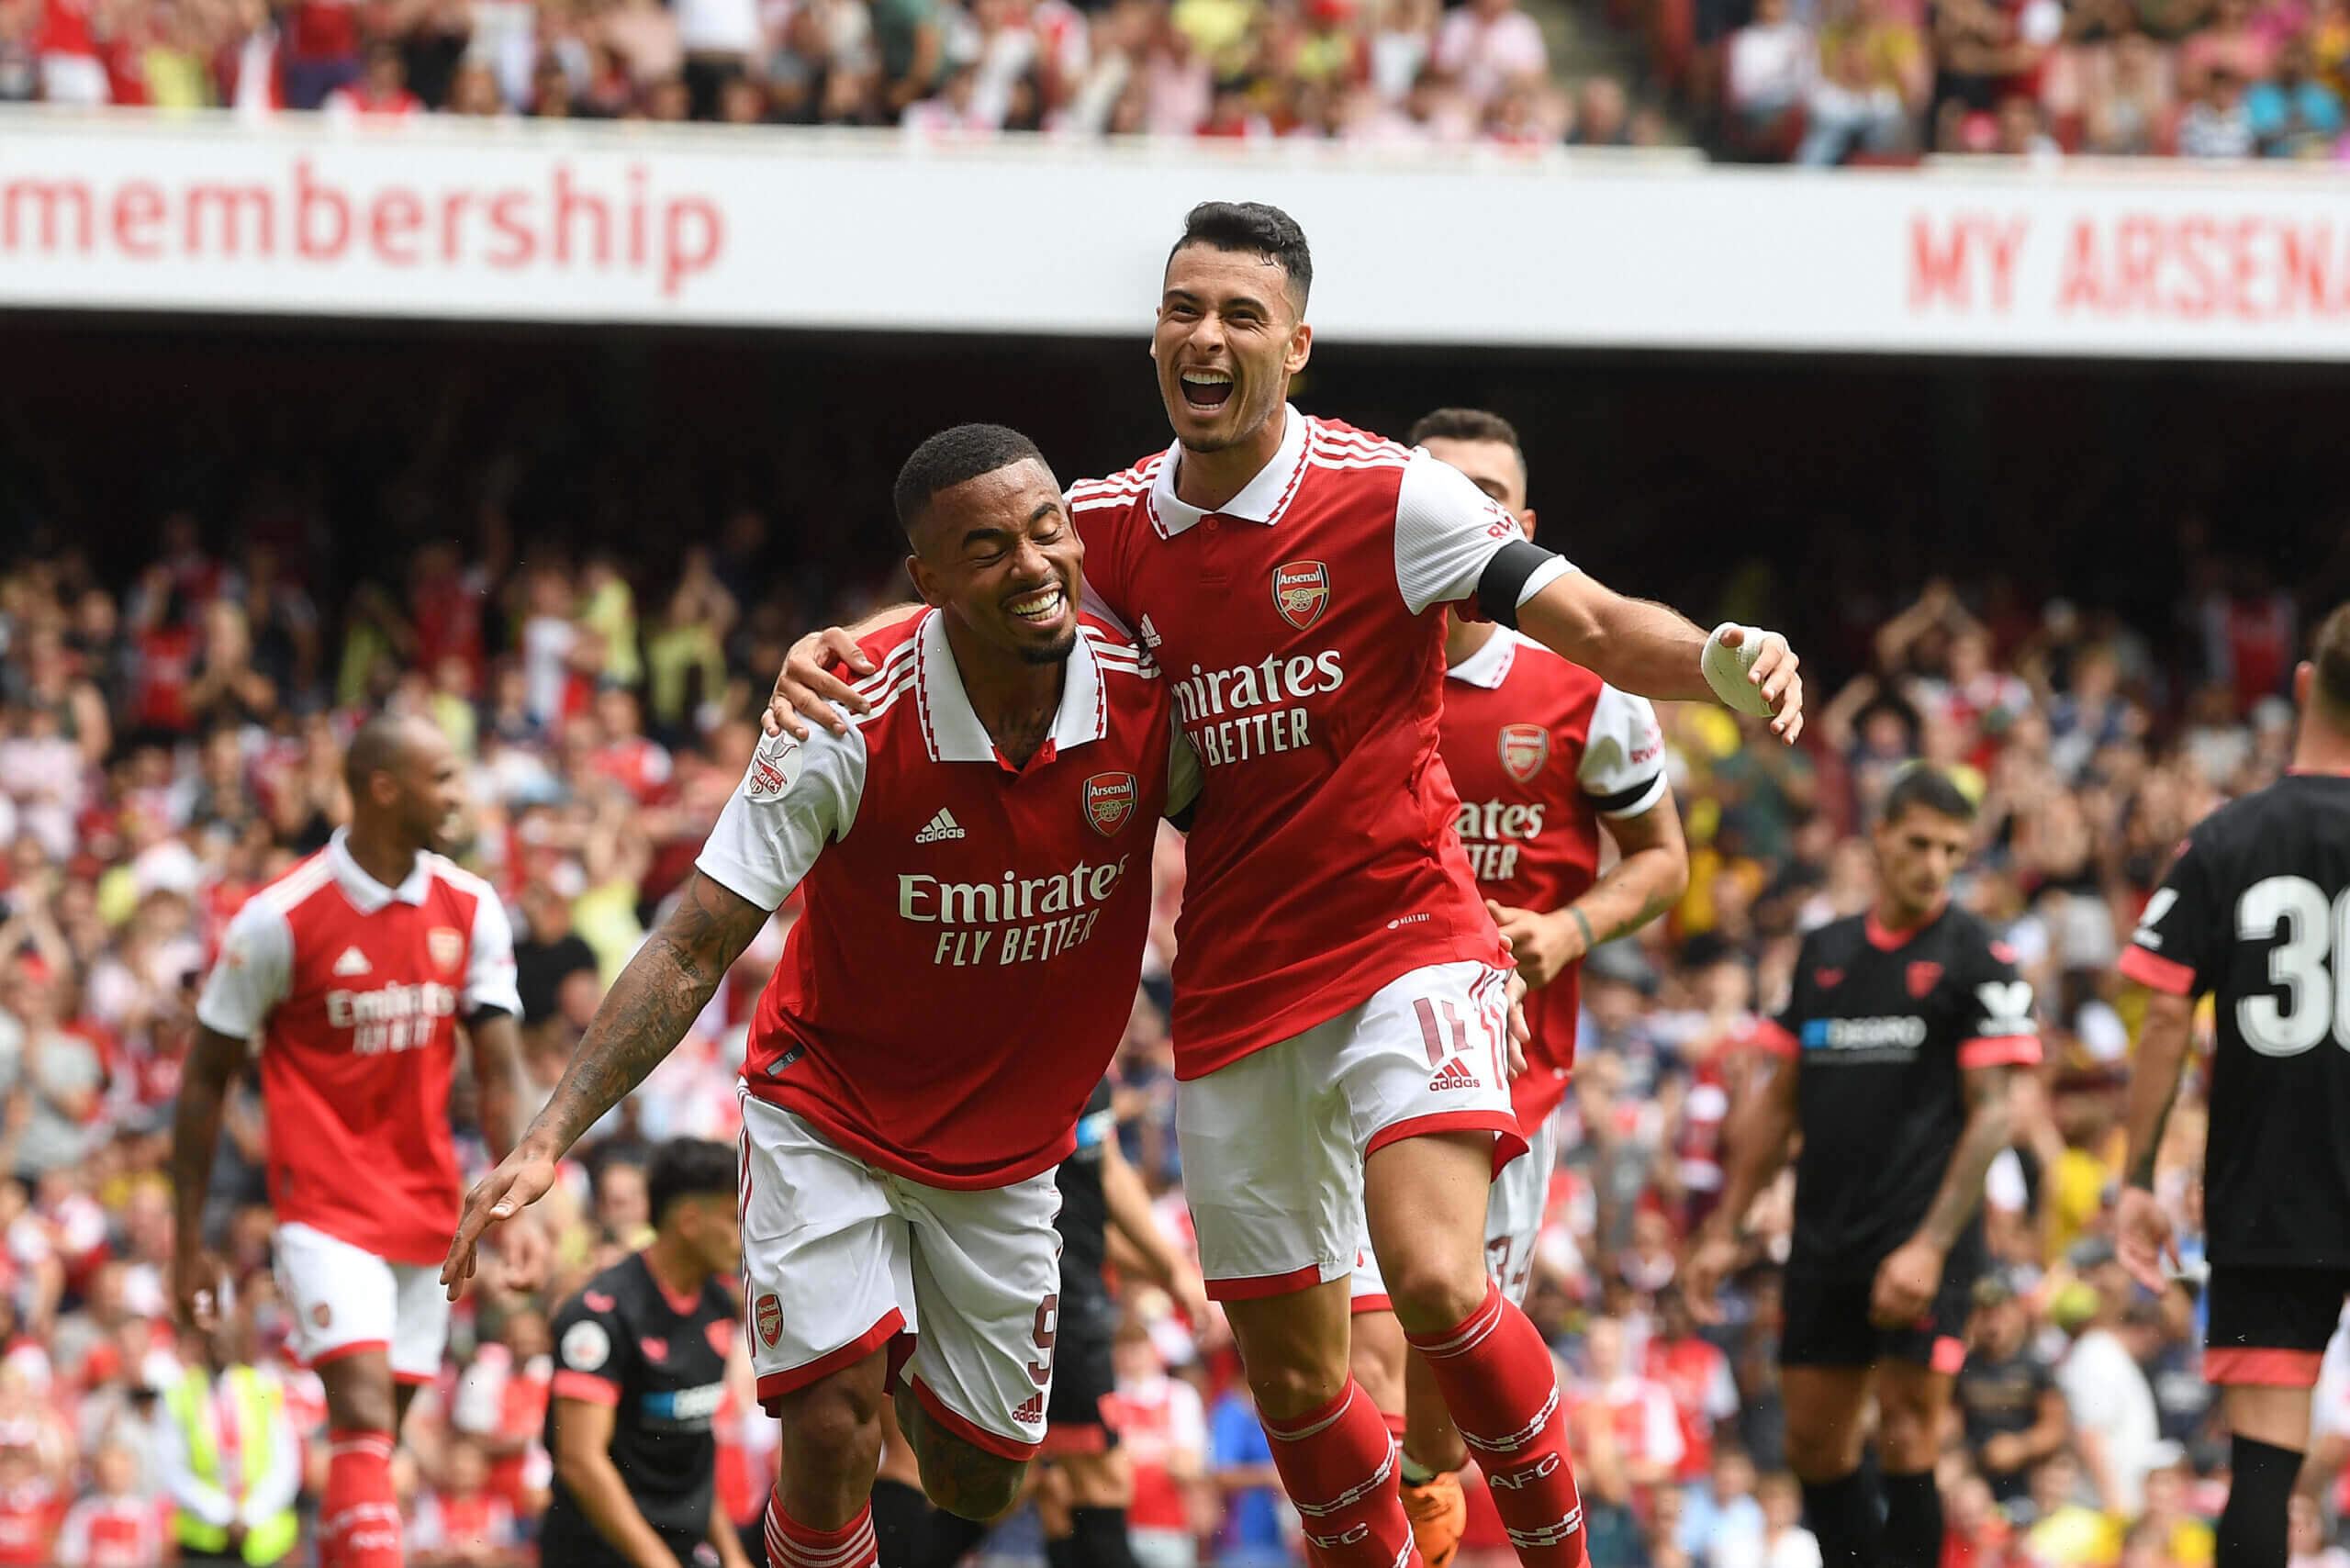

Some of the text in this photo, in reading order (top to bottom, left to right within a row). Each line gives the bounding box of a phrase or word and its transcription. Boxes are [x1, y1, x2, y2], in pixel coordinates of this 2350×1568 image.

[0, 158, 725, 297] membership
[1908, 212, 2028, 314] MY
[1279, 570, 1320, 585] Arsenal
[1204, 708, 1311, 767] BETTER
[1091, 782, 1130, 797] Arsenal
[915, 827, 965, 844] adidas
[1454, 797, 1546, 839] ates
[934, 908, 1100, 966] FLY BETTER
[2234, 875, 2350, 1057] 3
[1429, 1077, 1481, 1092] adidas
[1028, 1294, 1058, 1385] 9
[1490, 1452, 1560, 1490] AFC
